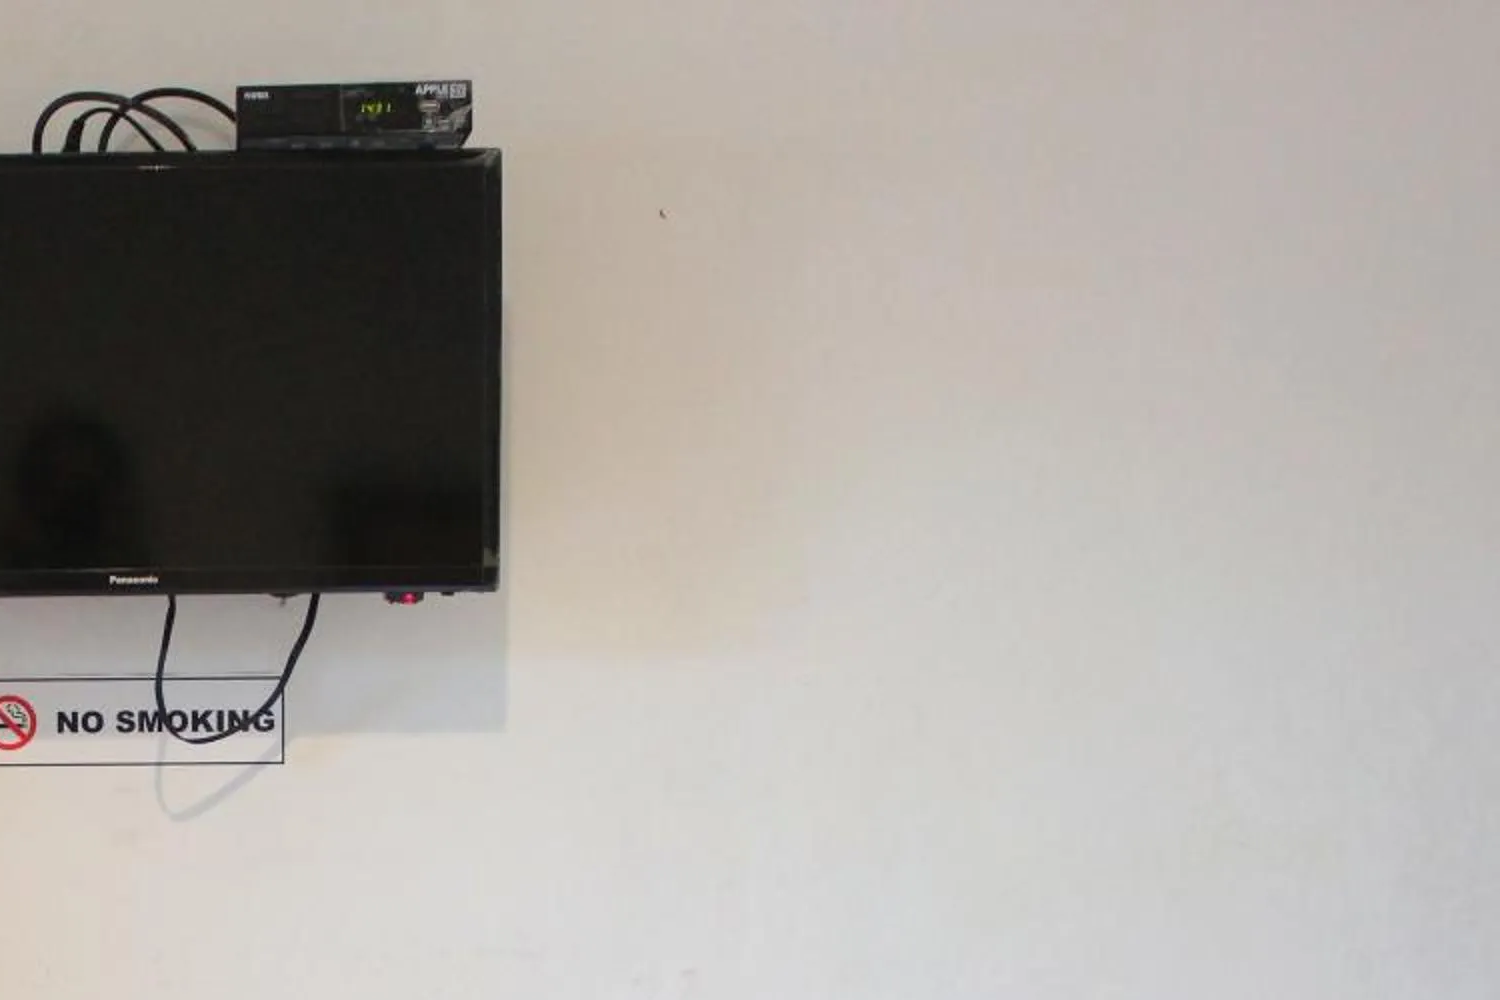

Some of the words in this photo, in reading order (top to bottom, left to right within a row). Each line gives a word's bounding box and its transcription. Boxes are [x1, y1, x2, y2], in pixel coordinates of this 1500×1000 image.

[109, 575, 159, 585] Panasonic
[57, 711, 103, 733] NO
[116, 709, 275, 733] SMOKING
